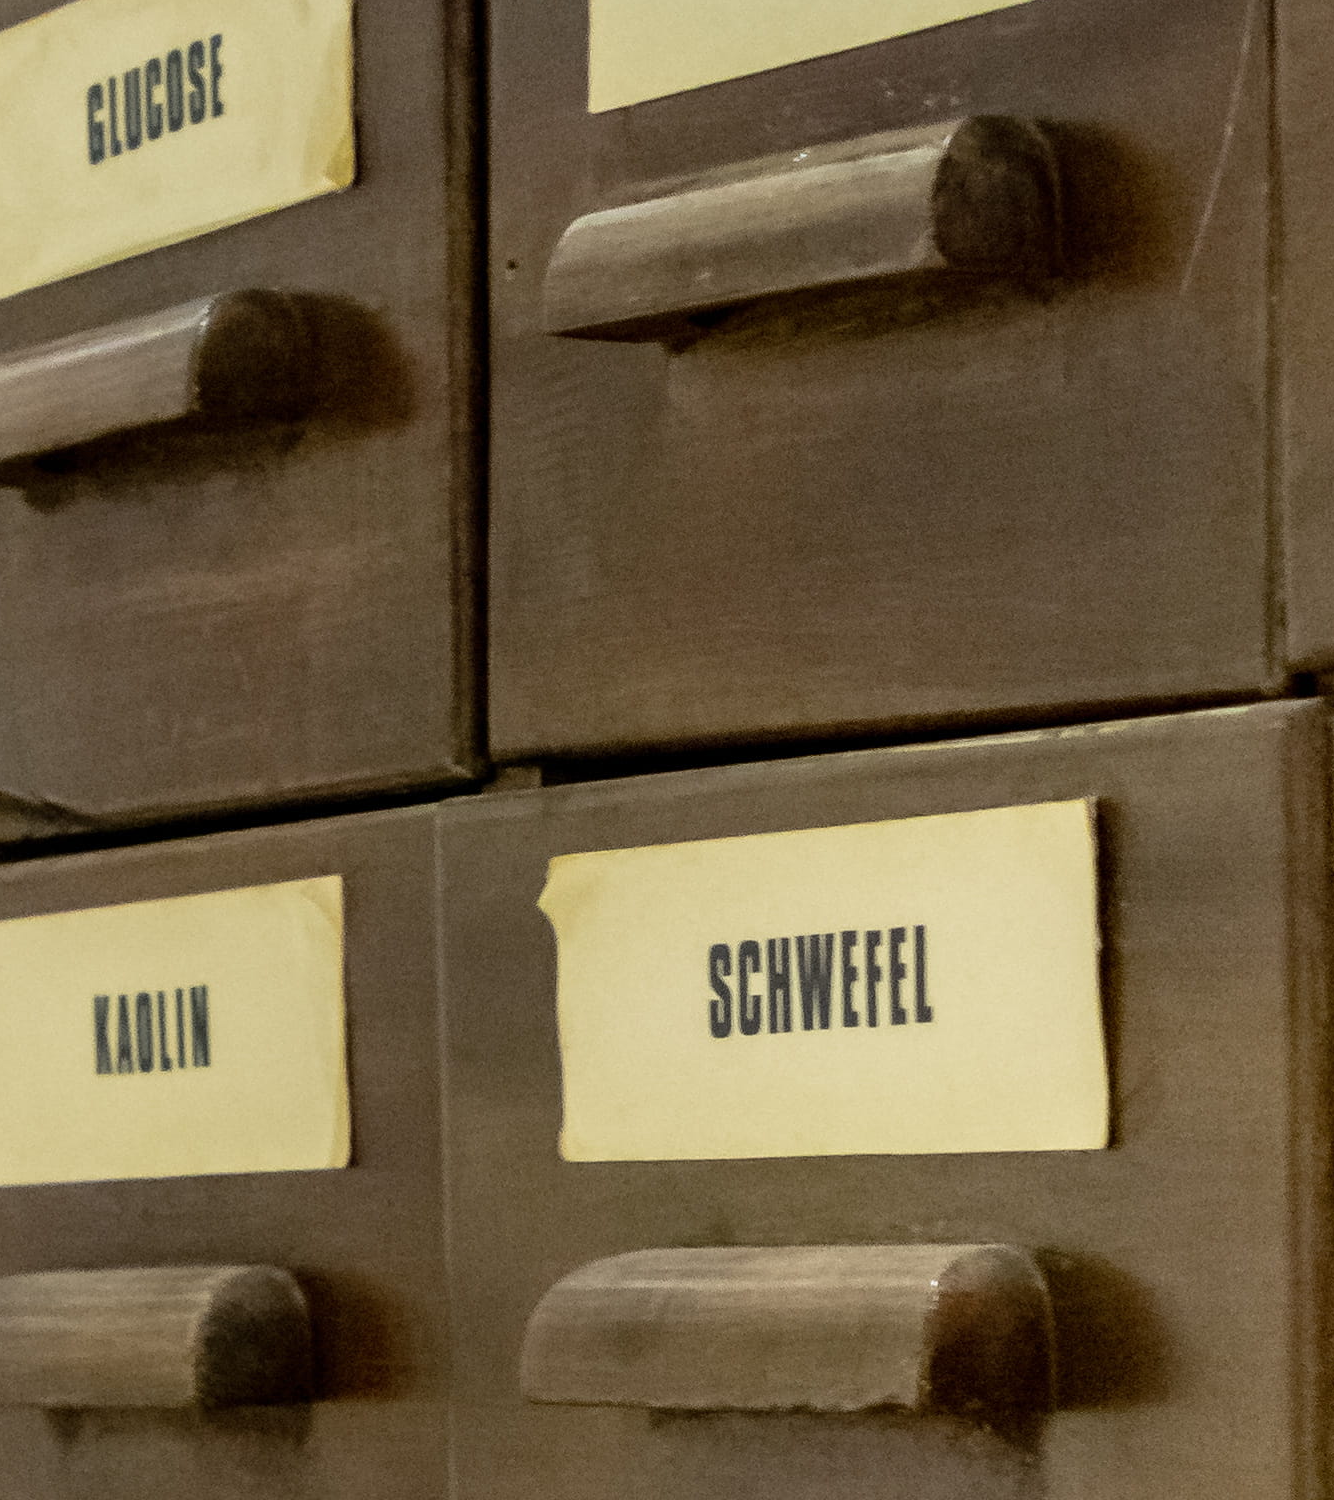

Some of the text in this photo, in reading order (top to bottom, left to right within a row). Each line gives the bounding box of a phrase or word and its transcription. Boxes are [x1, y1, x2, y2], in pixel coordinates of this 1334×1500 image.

[85, 32, 226, 167] GLUCOSE
[92, 984, 212, 1076] KAOLIN
[707, 923, 935, 1040] SCHWEFEL
